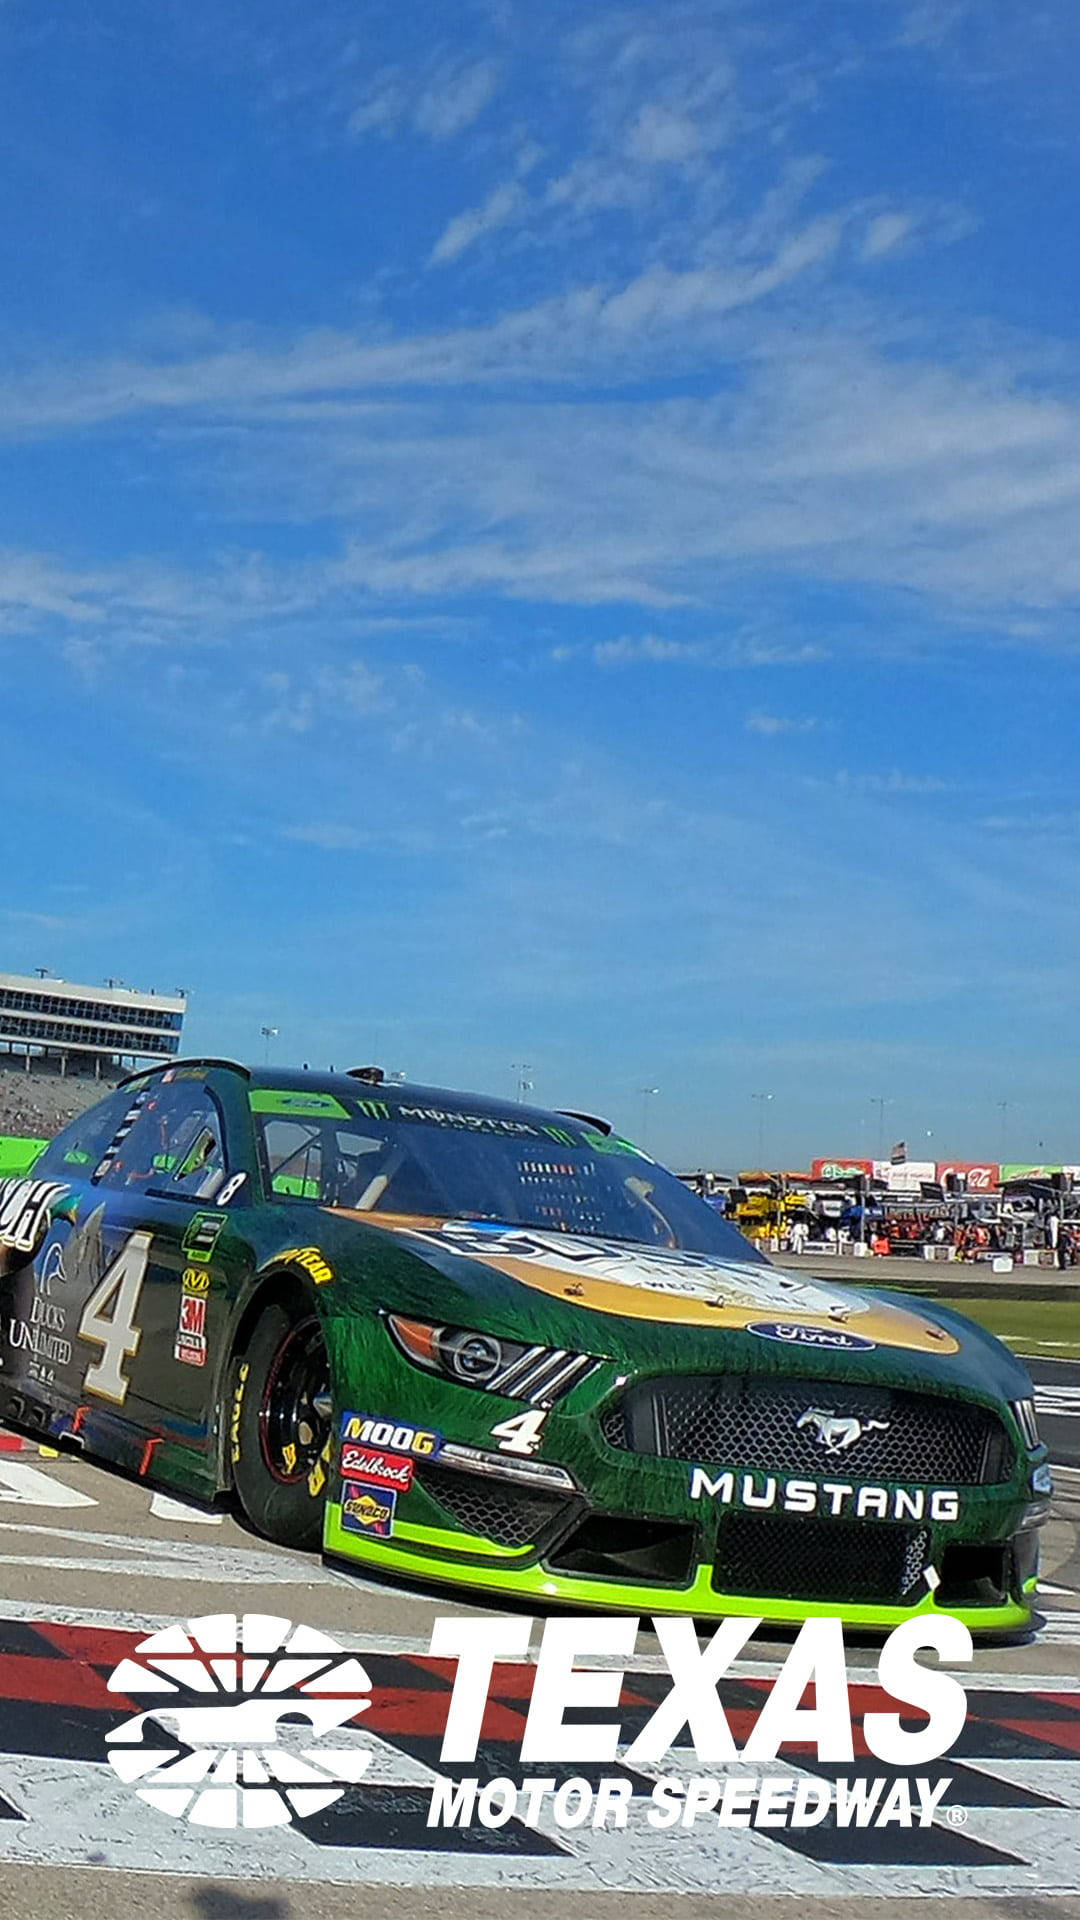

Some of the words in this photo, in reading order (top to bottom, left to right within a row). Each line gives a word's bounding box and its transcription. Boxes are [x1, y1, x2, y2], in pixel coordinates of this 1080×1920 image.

[216, 1172, 246, 1206] 8
[78, 1231, 153, 1404] 4
[344, 1417, 436, 1454] MOOG
[490, 1409, 547, 1456] 4
[345, 1500, 389, 1520] SUNOCO
[691, 1467, 959, 1521] MUSTANG
